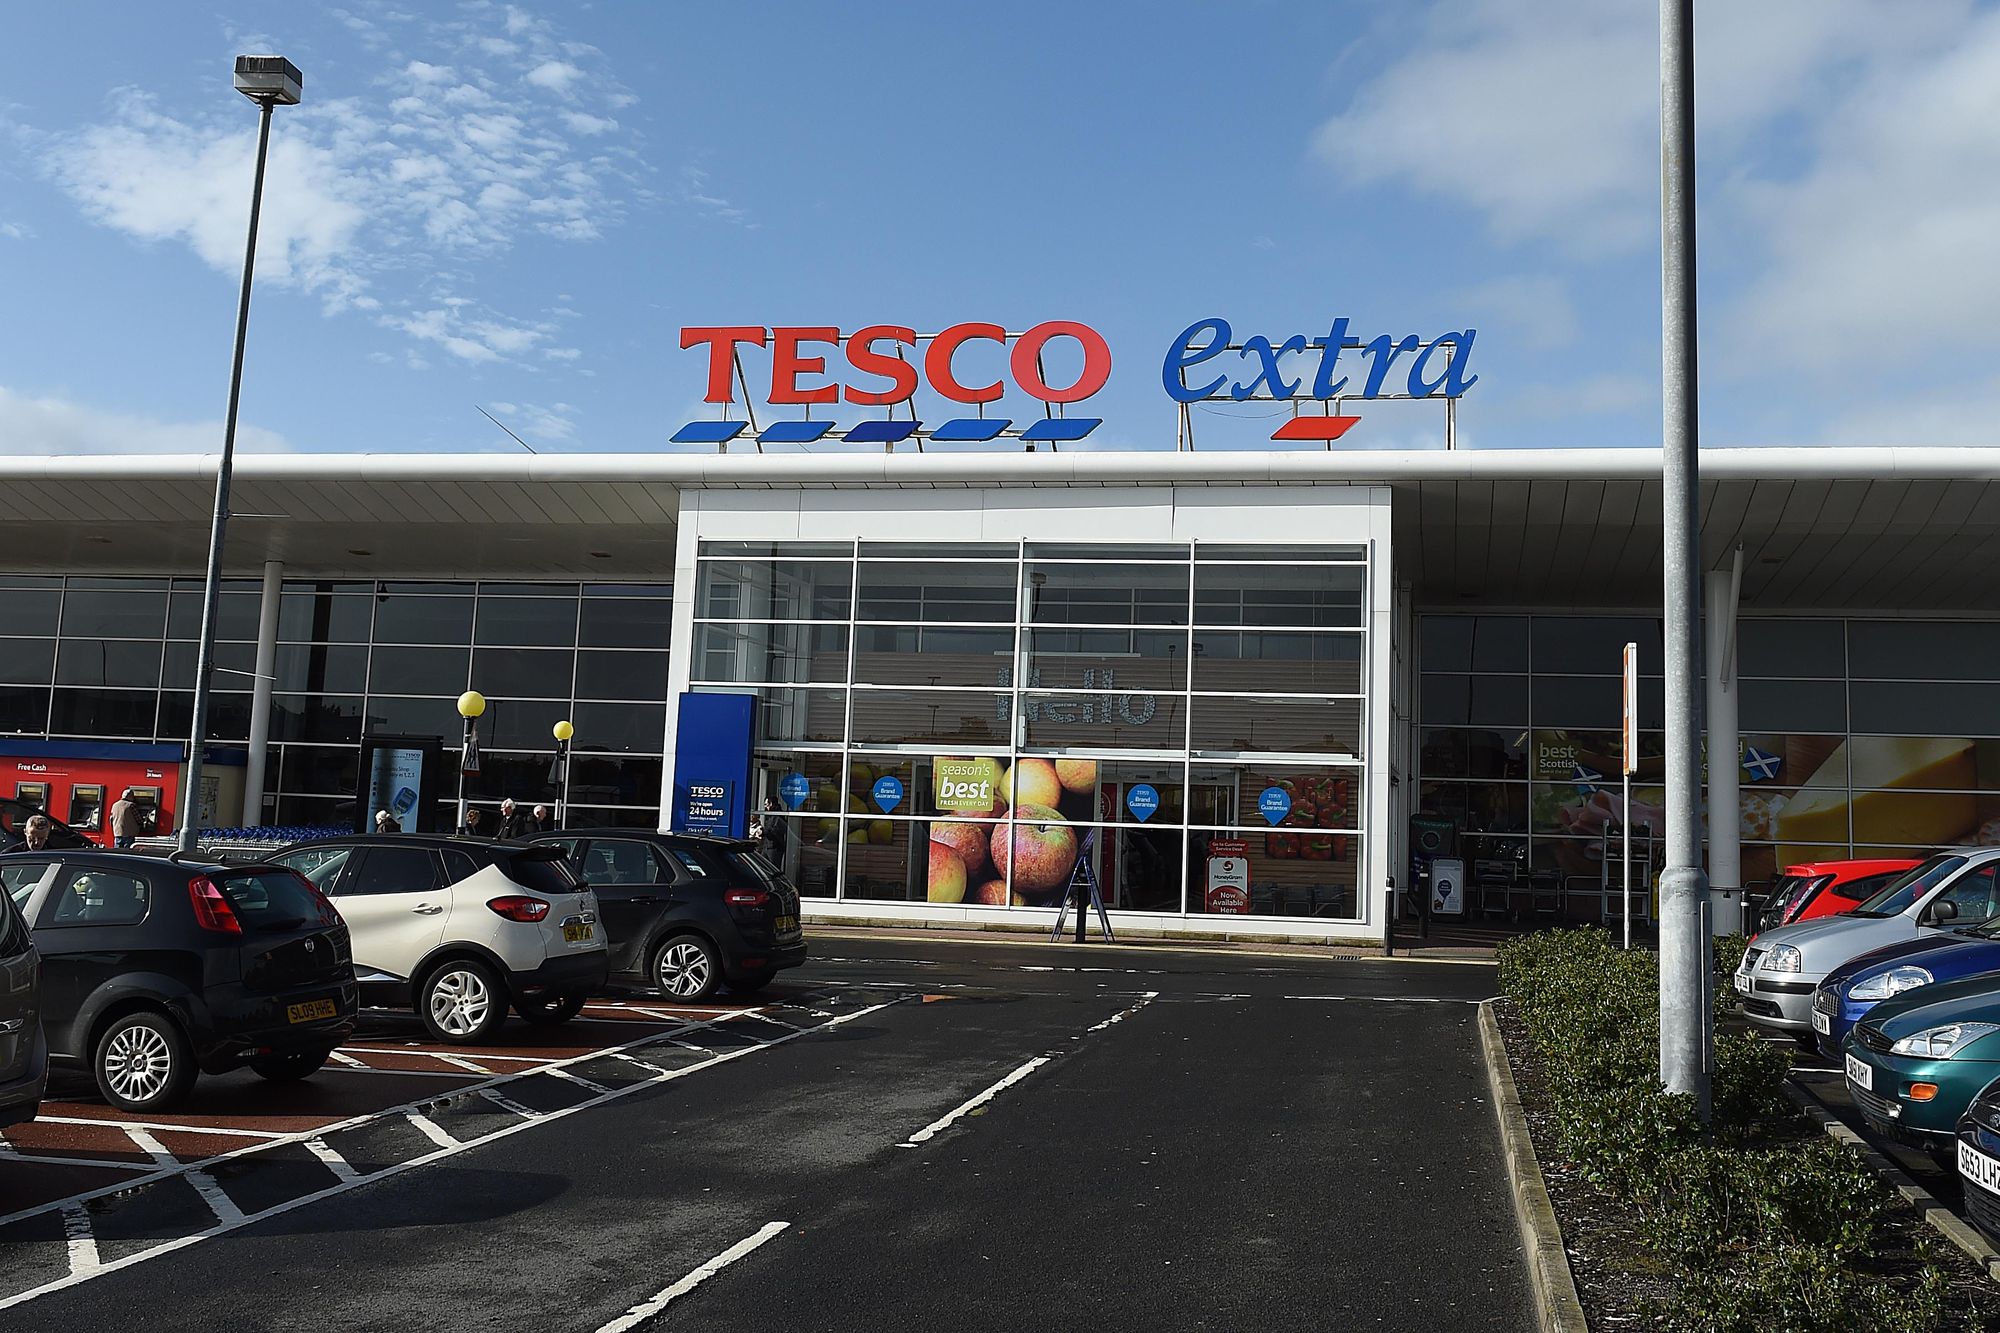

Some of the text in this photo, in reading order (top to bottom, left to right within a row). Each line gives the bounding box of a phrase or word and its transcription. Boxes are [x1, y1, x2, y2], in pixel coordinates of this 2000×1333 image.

[680, 317, 1479, 406] TESCO extra
[1539, 742, 1575, 758] best
[17, 763, 47, 771] Free Cash
[1539, 758, 1579, 768] Scottish
[941, 763, 990, 776] season's
[690, 786, 724, 795] TESCO
[940, 776, 990, 799] best
[1130, 800, 1157, 808] Guarantee
[689, 807, 724, 816] 24 hours
[1220, 906, 1238, 914] Here
[290, 1003, 316, 1021] SL09
[1960, 1145, 1981, 1180] SG53
